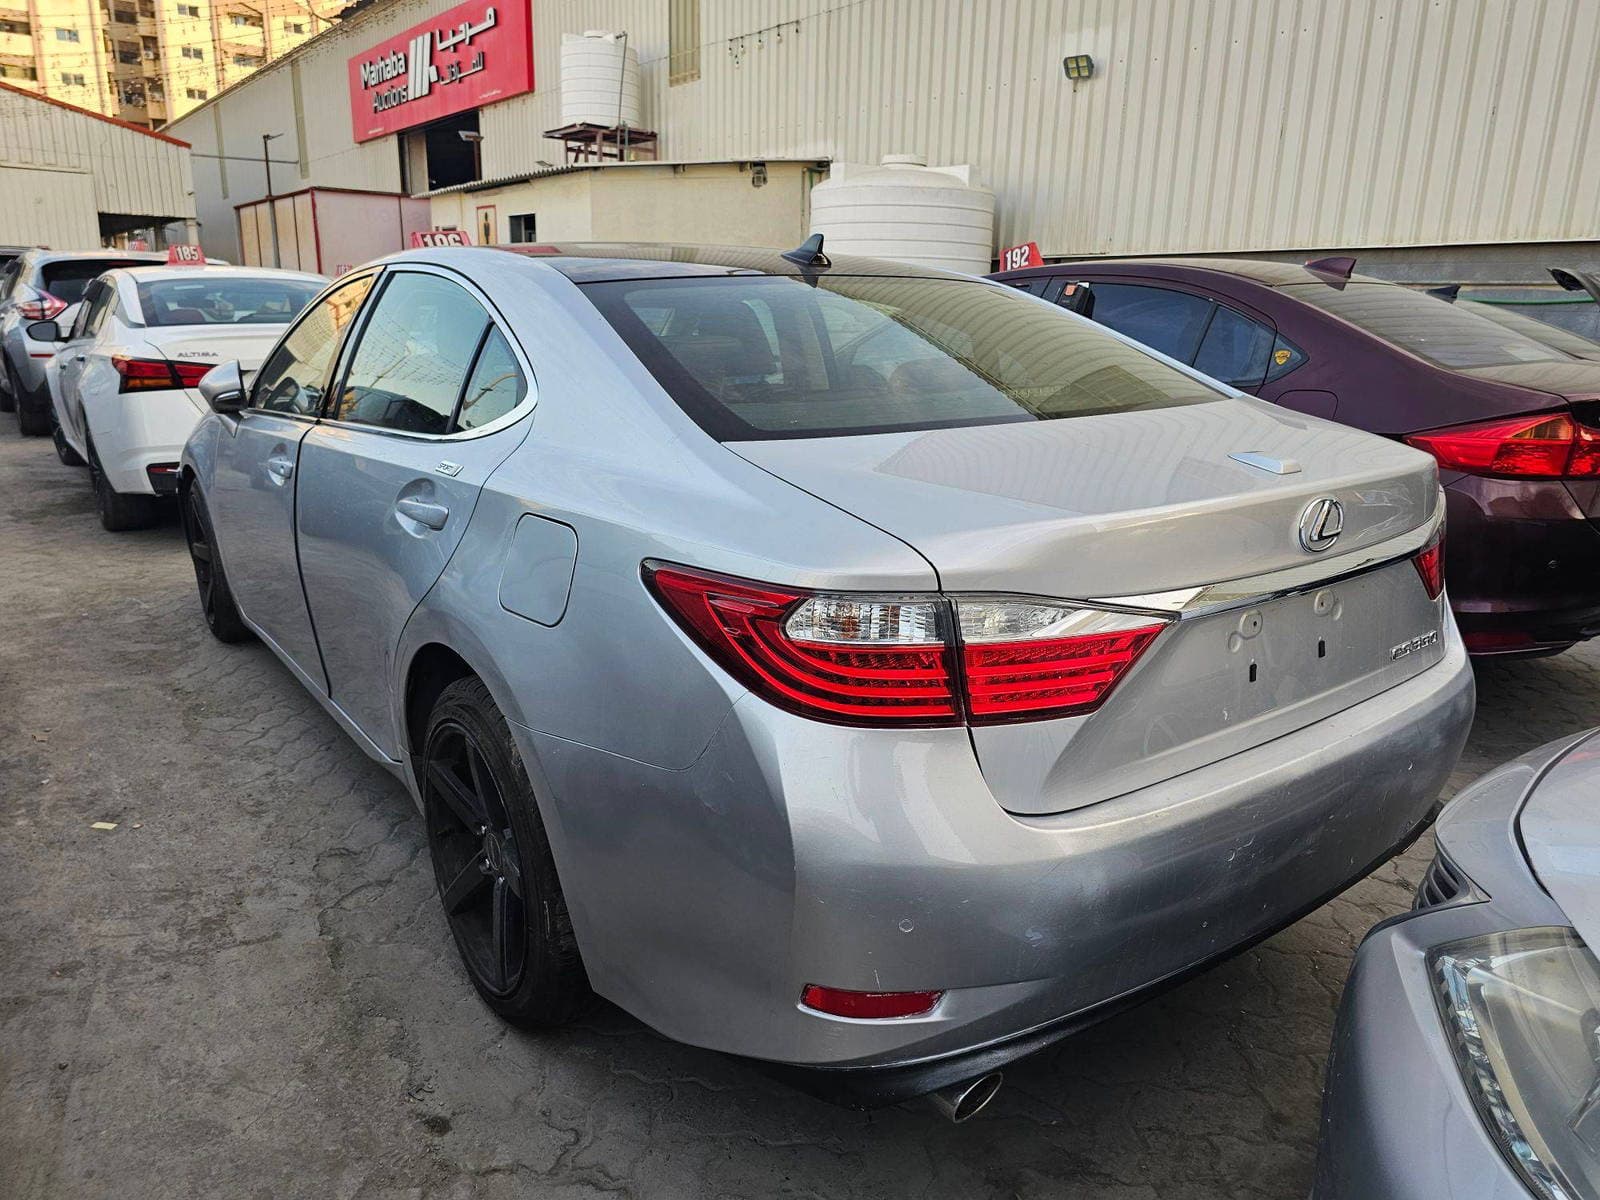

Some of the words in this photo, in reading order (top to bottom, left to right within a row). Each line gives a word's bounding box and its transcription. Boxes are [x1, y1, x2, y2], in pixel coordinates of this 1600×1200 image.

[360, 49, 406, 90] Marhaba
[373, 84, 408, 113] Auctions
[176, 246, 199, 261] 185
[1005, 245, 1030, 272] 192
